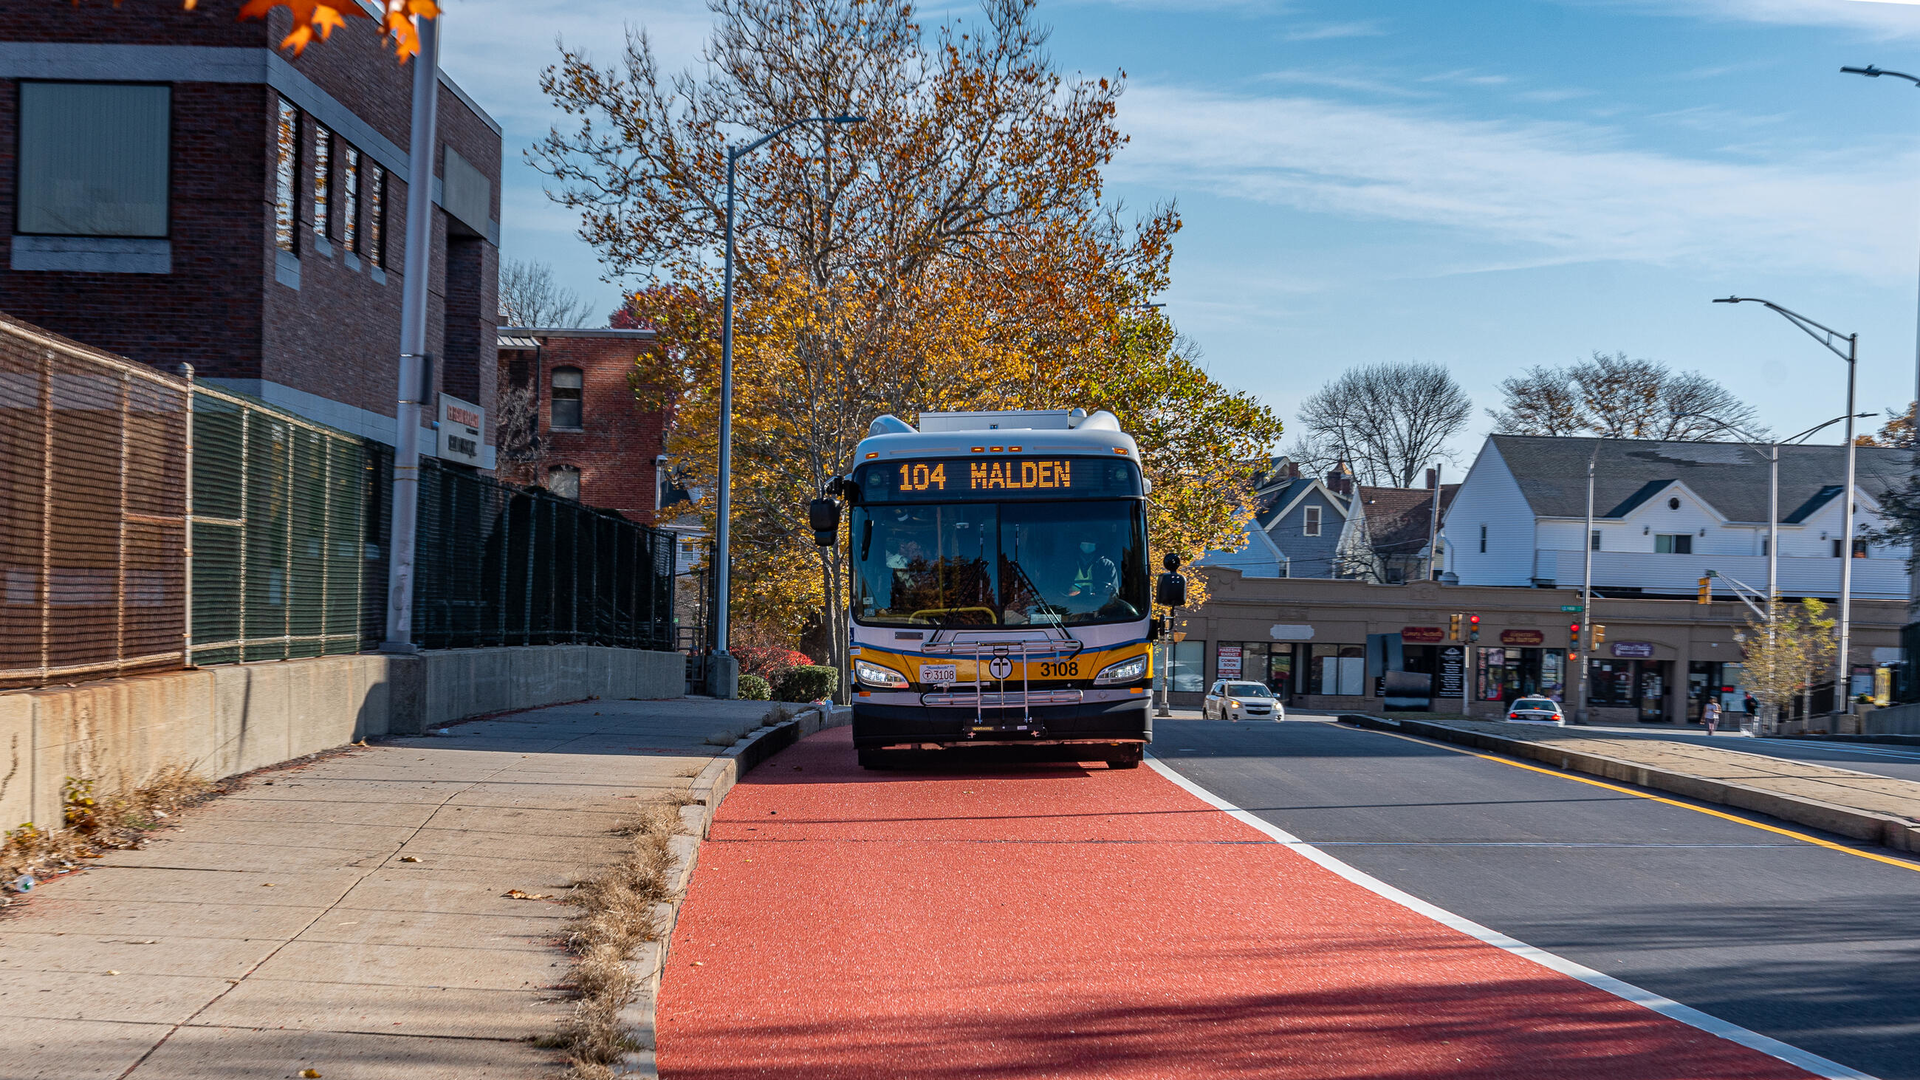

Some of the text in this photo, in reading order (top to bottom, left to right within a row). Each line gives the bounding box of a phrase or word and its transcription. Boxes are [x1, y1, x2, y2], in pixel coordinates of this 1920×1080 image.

[899, 460, 1070, 490] 104 MALDEN
[933, 670, 955, 680] 3108
[1040, 661, 1079, 676] 3108
